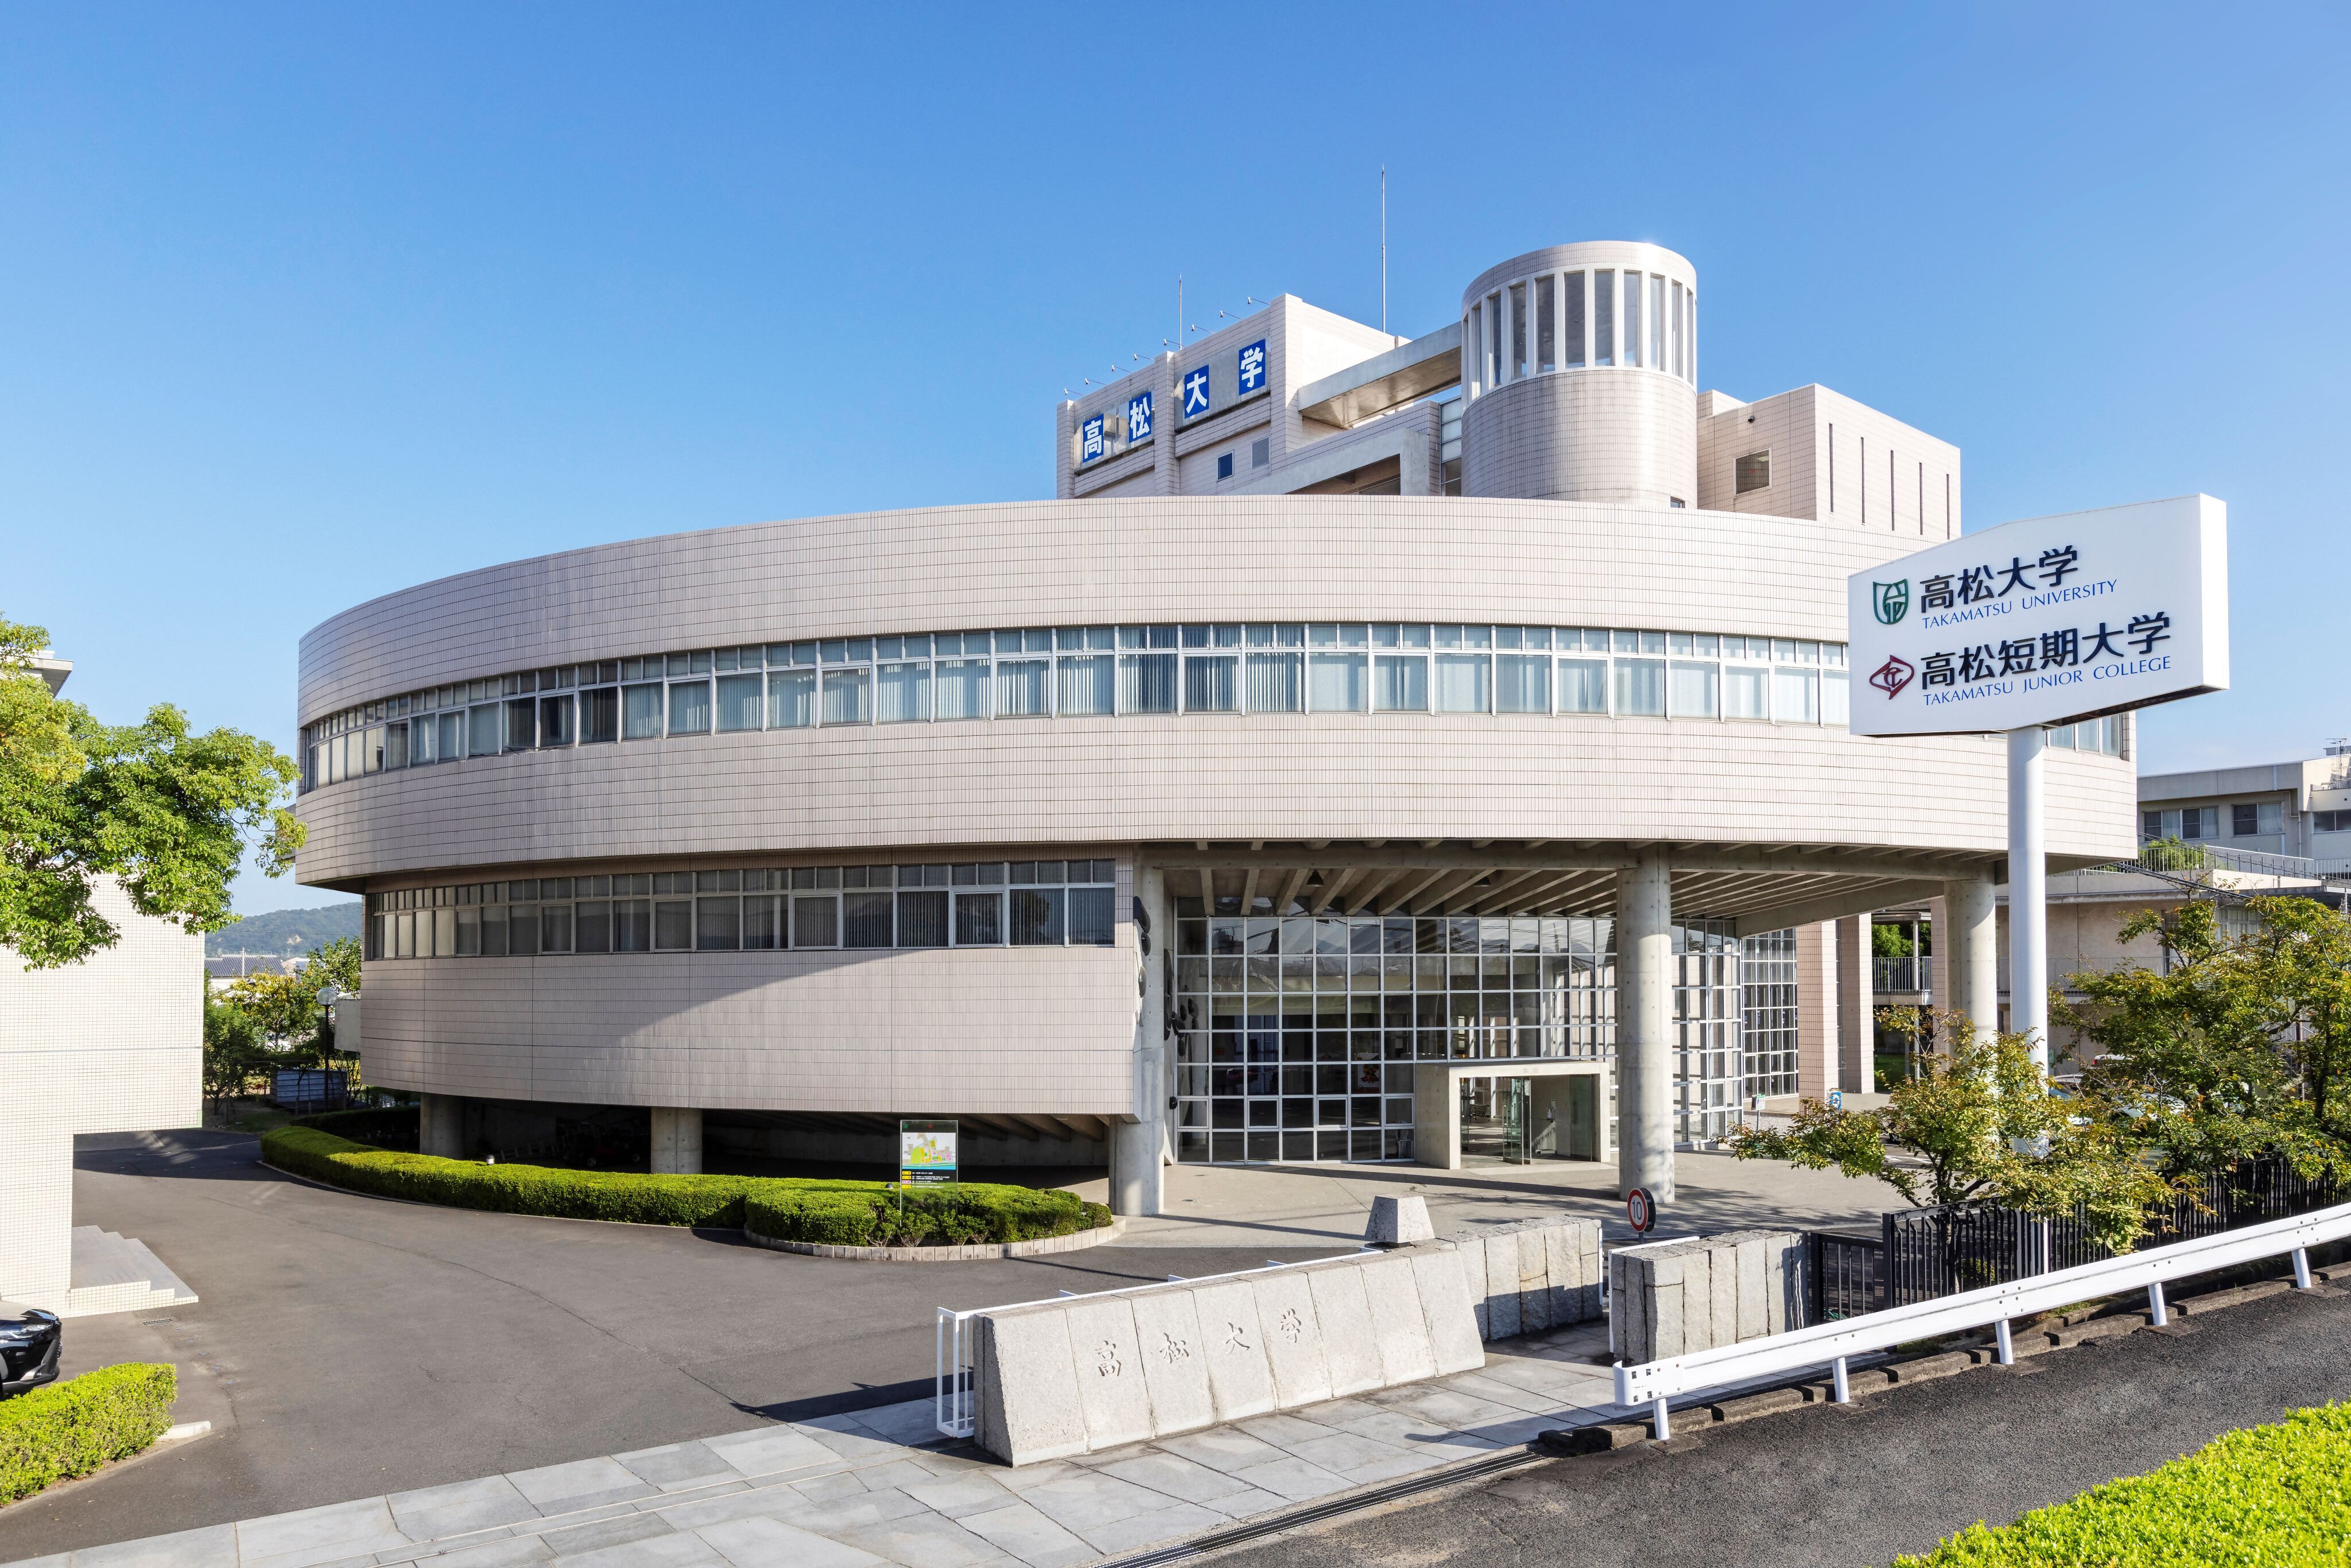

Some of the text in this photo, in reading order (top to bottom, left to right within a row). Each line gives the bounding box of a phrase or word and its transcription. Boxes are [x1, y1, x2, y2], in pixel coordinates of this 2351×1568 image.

[1084, 347, 1264, 460] 高松大学
[1920, 545, 2078, 614] 高松大学
[1922, 579, 2117, 629] TAKAMATSU UNIVERSITY
[1921, 611, 2171, 690] 高松短期大学
[1923, 655, 2171, 705] TAKAMATSU JUNIOR COLLEGE
[1632, 1200, 1642, 1220] 10
